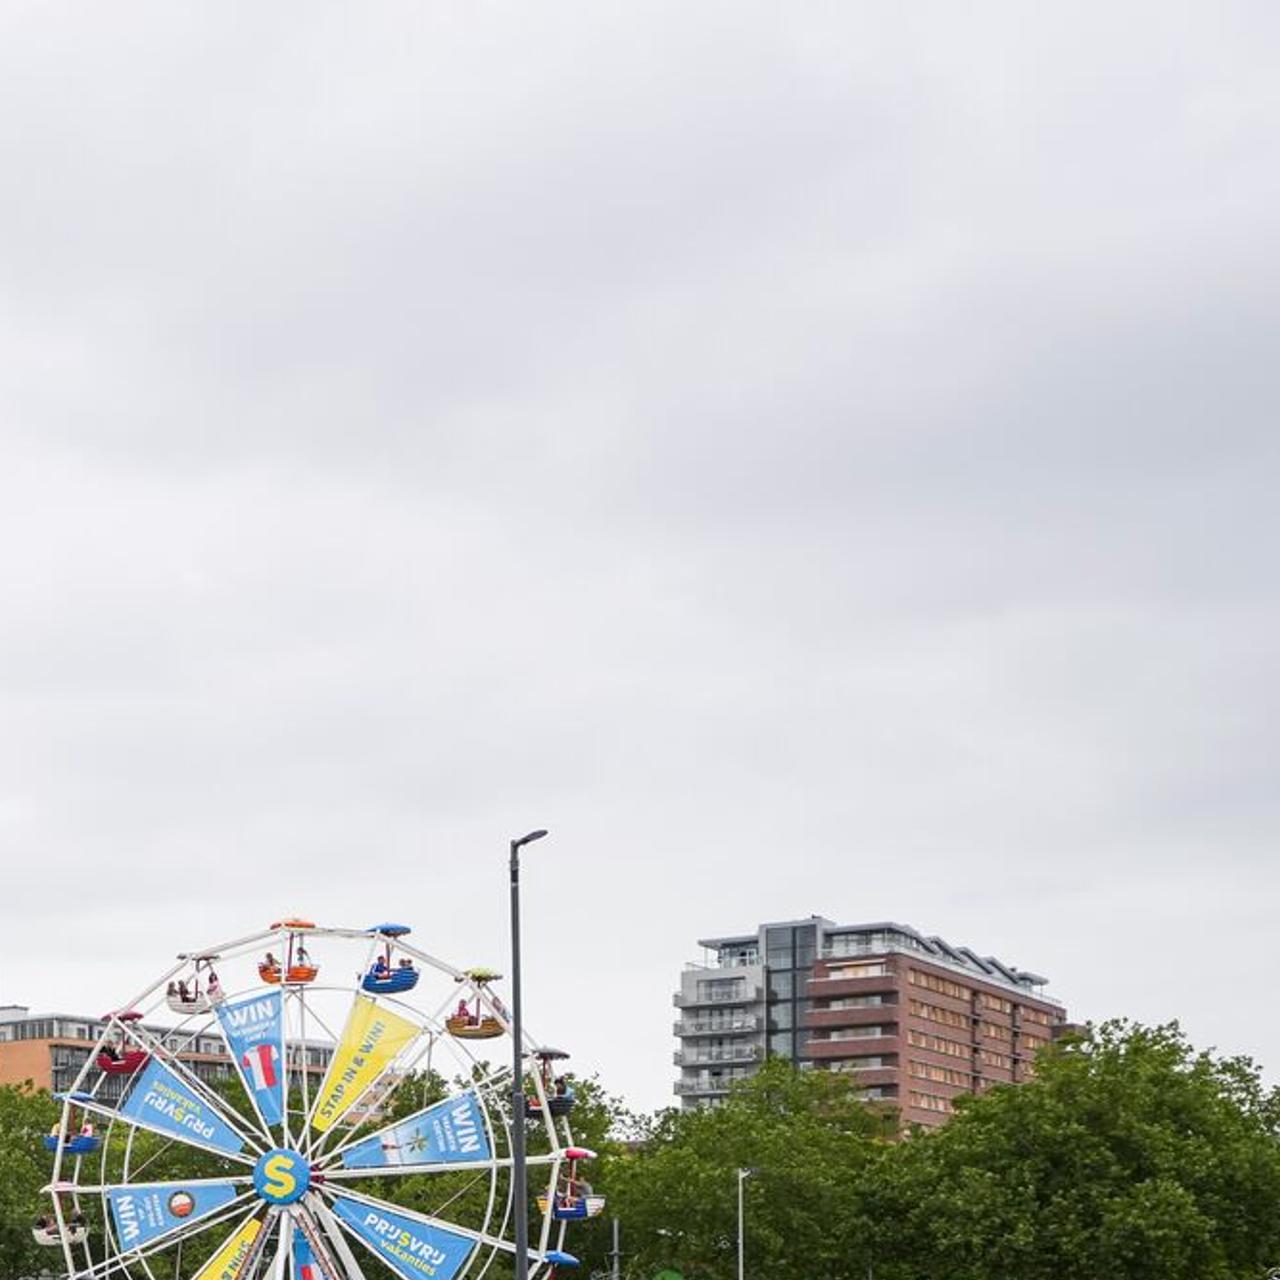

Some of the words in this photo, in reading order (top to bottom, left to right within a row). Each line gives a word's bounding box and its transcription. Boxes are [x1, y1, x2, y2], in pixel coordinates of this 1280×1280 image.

[226, 1000, 273, 1027] WIN
[452, 1102, 481, 1153] WIN
[117, 1195, 141, 1242] WIN
[364, 1212, 447, 1265] PRIJSVRIJ
